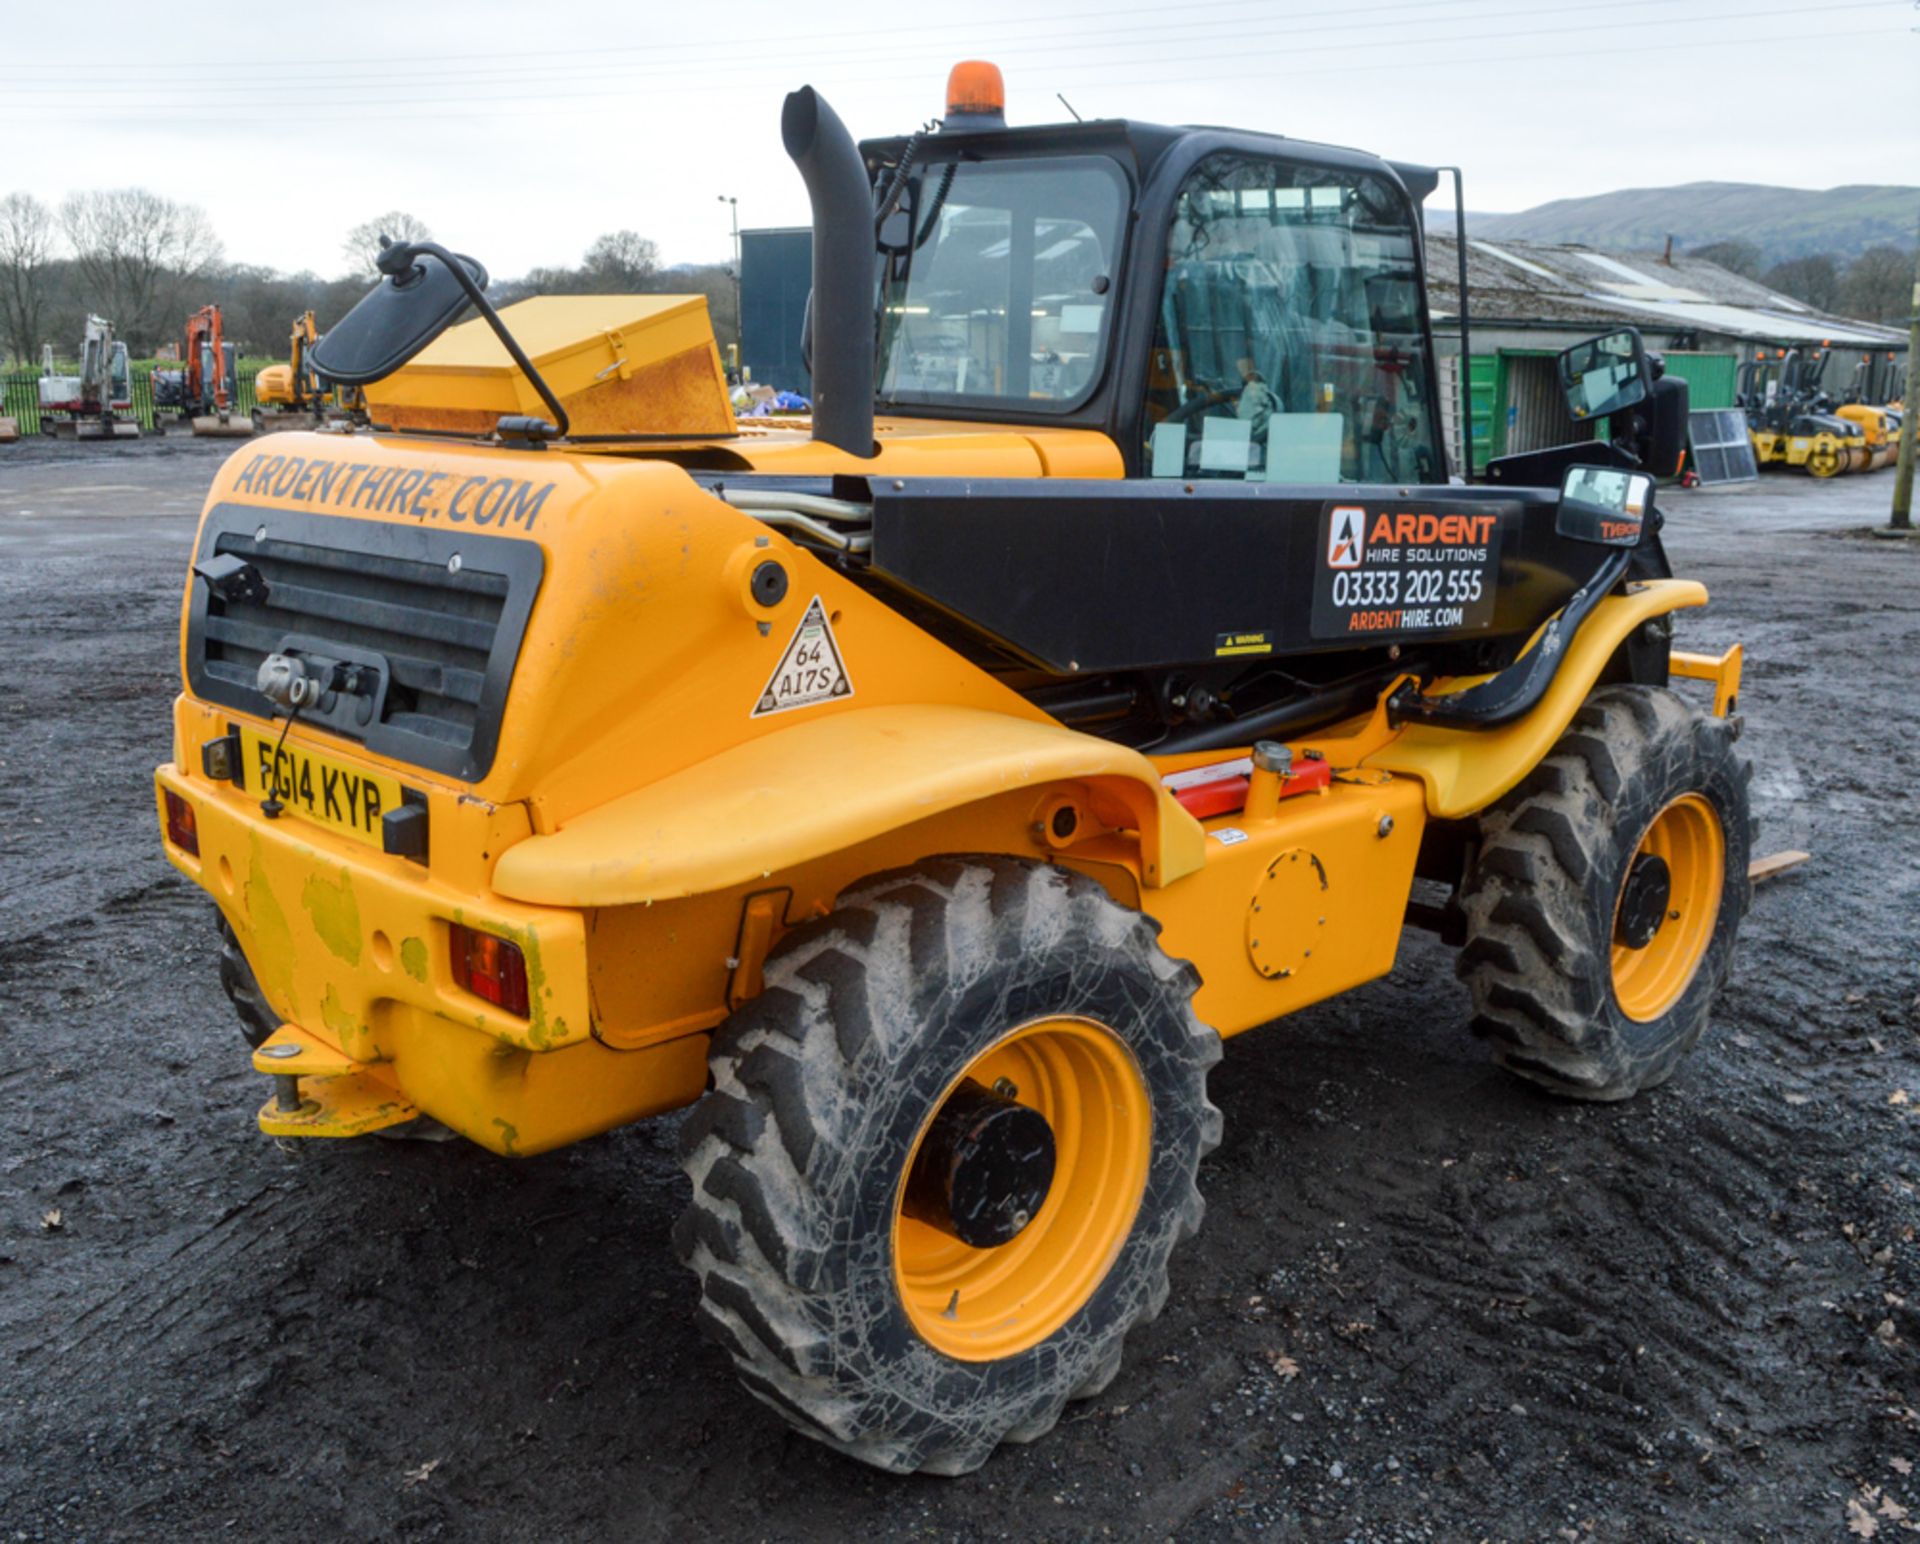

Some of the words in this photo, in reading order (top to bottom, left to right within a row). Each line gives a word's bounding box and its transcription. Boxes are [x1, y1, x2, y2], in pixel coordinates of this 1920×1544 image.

[233, 453, 557, 531] ARDENTHIRE.COM
[1369, 513, 1497, 544] ARDENT
[1366, 548, 1400, 562] HIRE
[1406, 548, 1487, 562] SOLUTIONS
[1333, 570, 1400, 607] 03333
[1404, 569, 1443, 604] 202
[1446, 569, 1482, 601] 555
[1349, 608, 1463, 631] ARDENTHIRE.COM
[796, 640, 821, 666] 64
[321, 765, 381, 832] KYP
